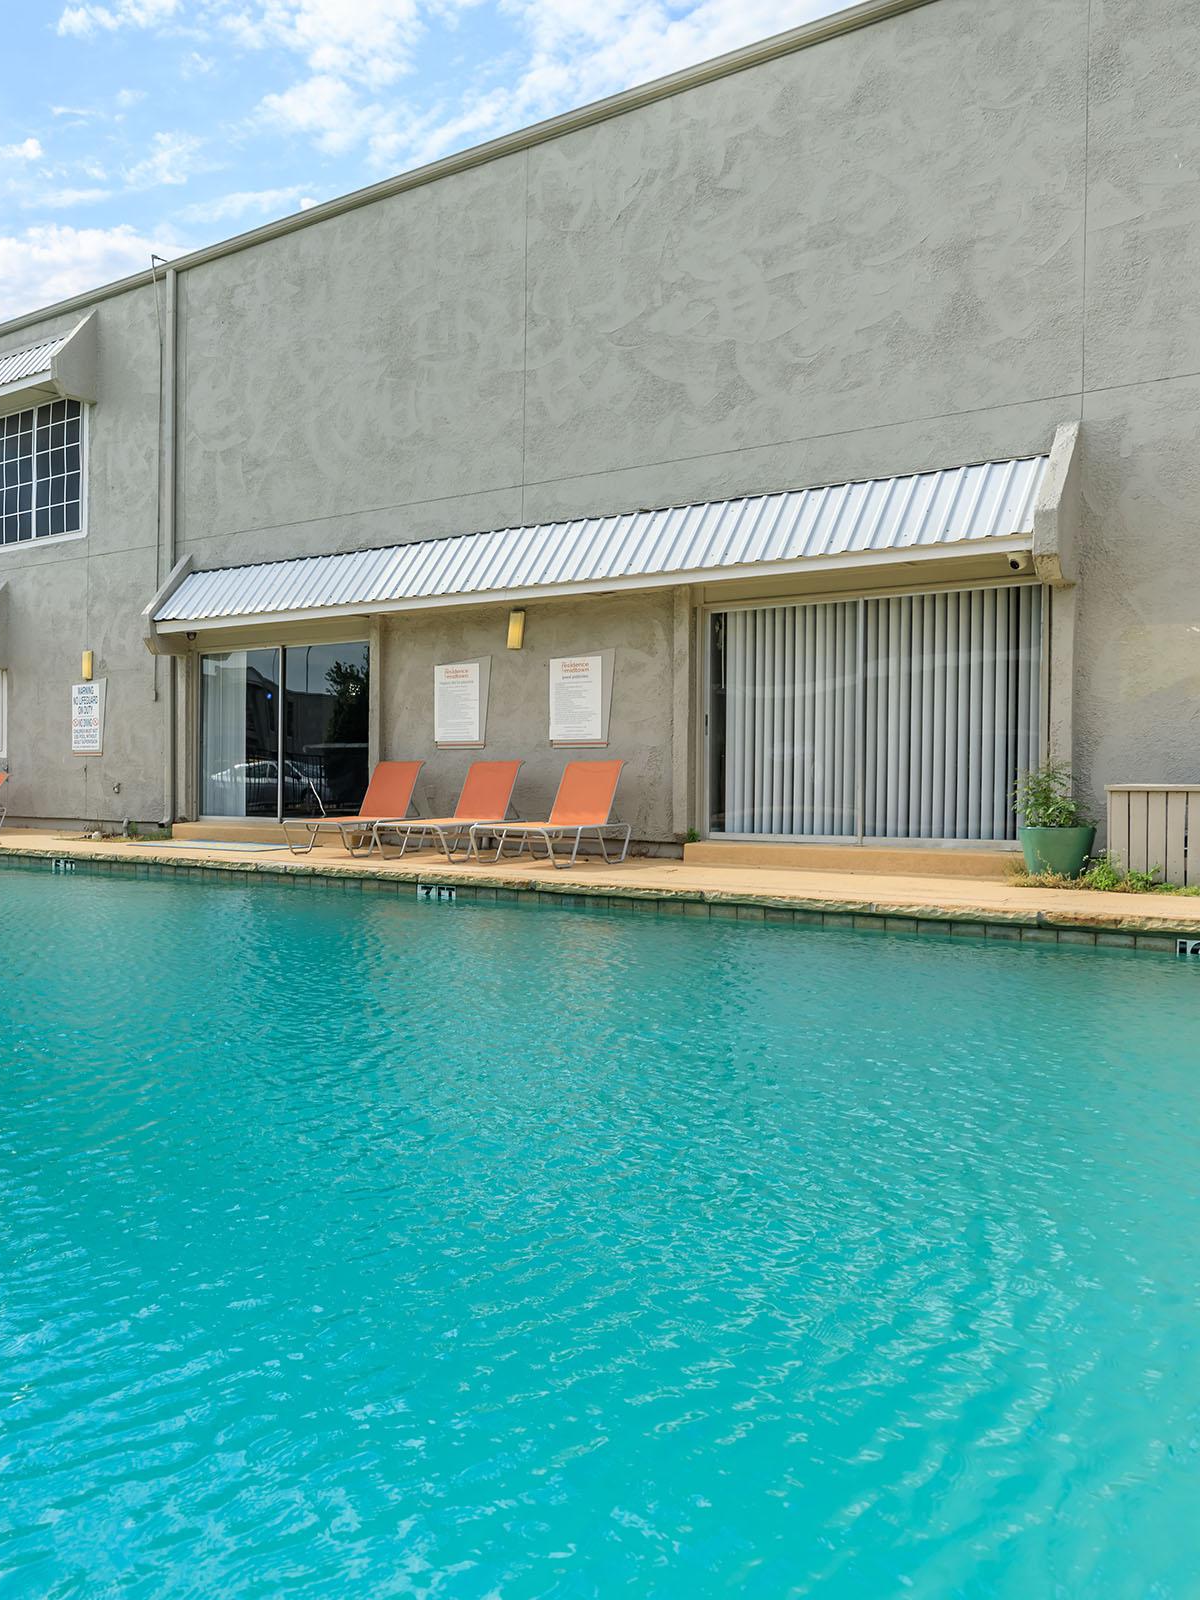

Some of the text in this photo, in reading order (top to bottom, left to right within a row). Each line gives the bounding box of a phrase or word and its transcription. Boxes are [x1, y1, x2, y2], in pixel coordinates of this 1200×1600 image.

[77, 686, 94, 695] WARNING
[73, 696, 98, 705] NO LIFEGUARD
[78, 705, 93, 715] ON DUTY
[79, 719, 85, 728] NO
[420, 886, 434, 899] 7
